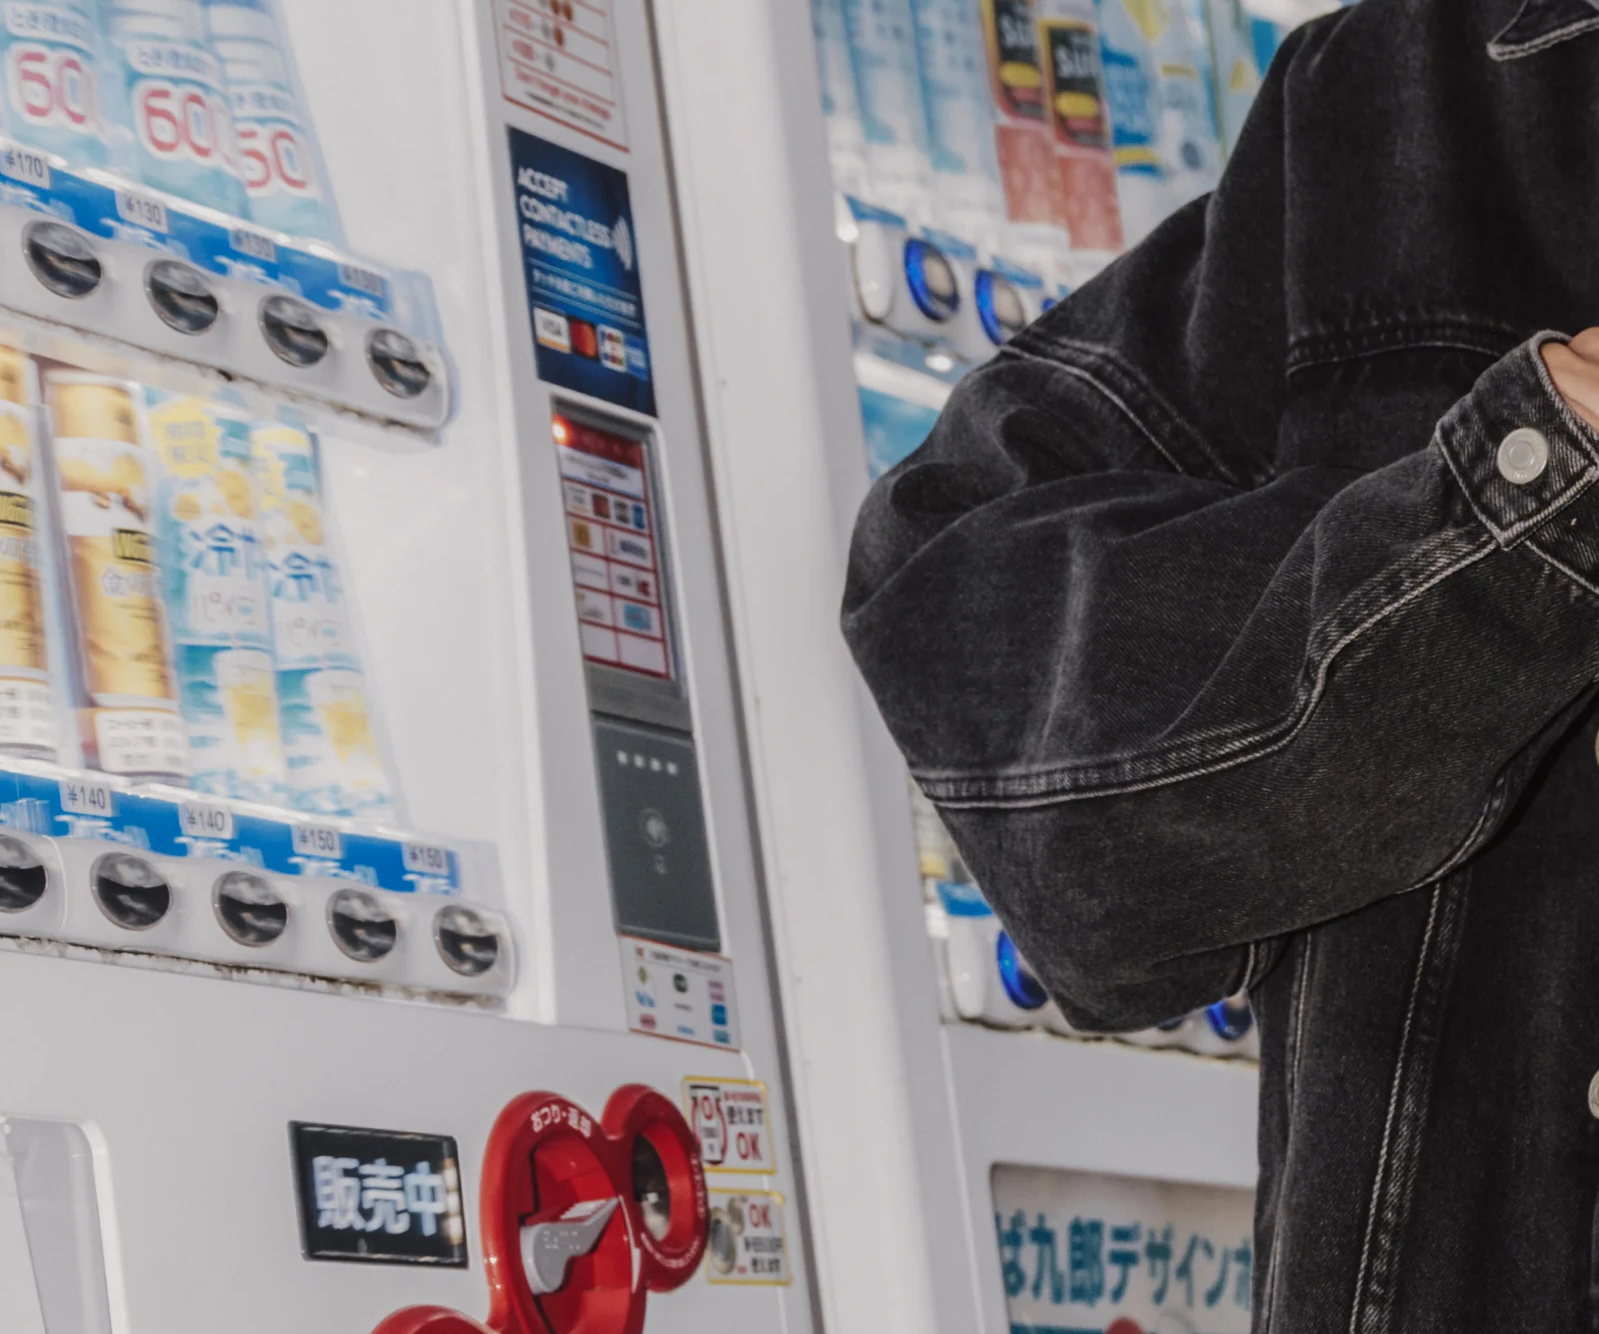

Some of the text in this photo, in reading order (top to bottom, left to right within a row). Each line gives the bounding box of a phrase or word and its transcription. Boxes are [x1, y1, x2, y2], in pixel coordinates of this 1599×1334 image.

[518, 166, 568, 203] ACCEPT
[519, 195, 612, 249] CONTACTLESS
[523, 223, 593, 269] PAYMENTS
[66, 783, 106, 810] ¥140
[186, 807, 225, 832] ¥140
[736, 1132, 763, 1161] OK
[313, 1155, 448, 1237] 販売中
[750, 1204, 772, 1229] OK
